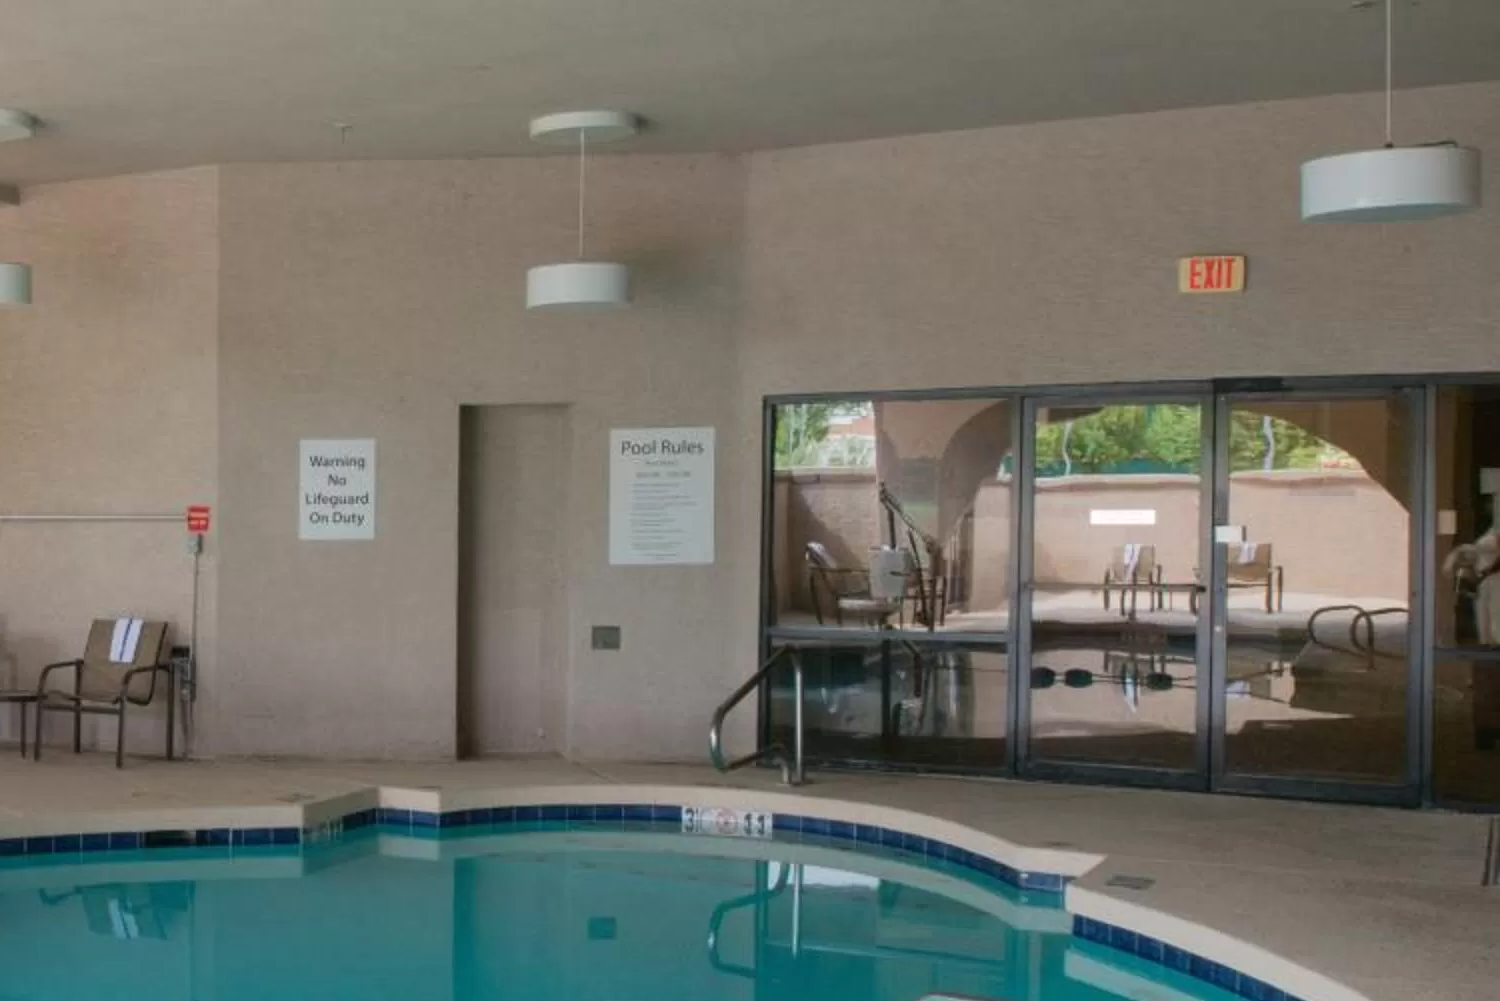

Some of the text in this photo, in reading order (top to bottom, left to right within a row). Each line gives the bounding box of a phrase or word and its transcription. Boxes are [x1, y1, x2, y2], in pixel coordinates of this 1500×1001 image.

[1188, 256, 1236, 289] EXIT
[621, 439, 705, 455] Pool Rules
[309, 456, 365, 471] Warning
[328, 474, 347, 487] No
[305, 491, 369, 508] Lifeguard
[309, 511, 365, 527] On Duty
